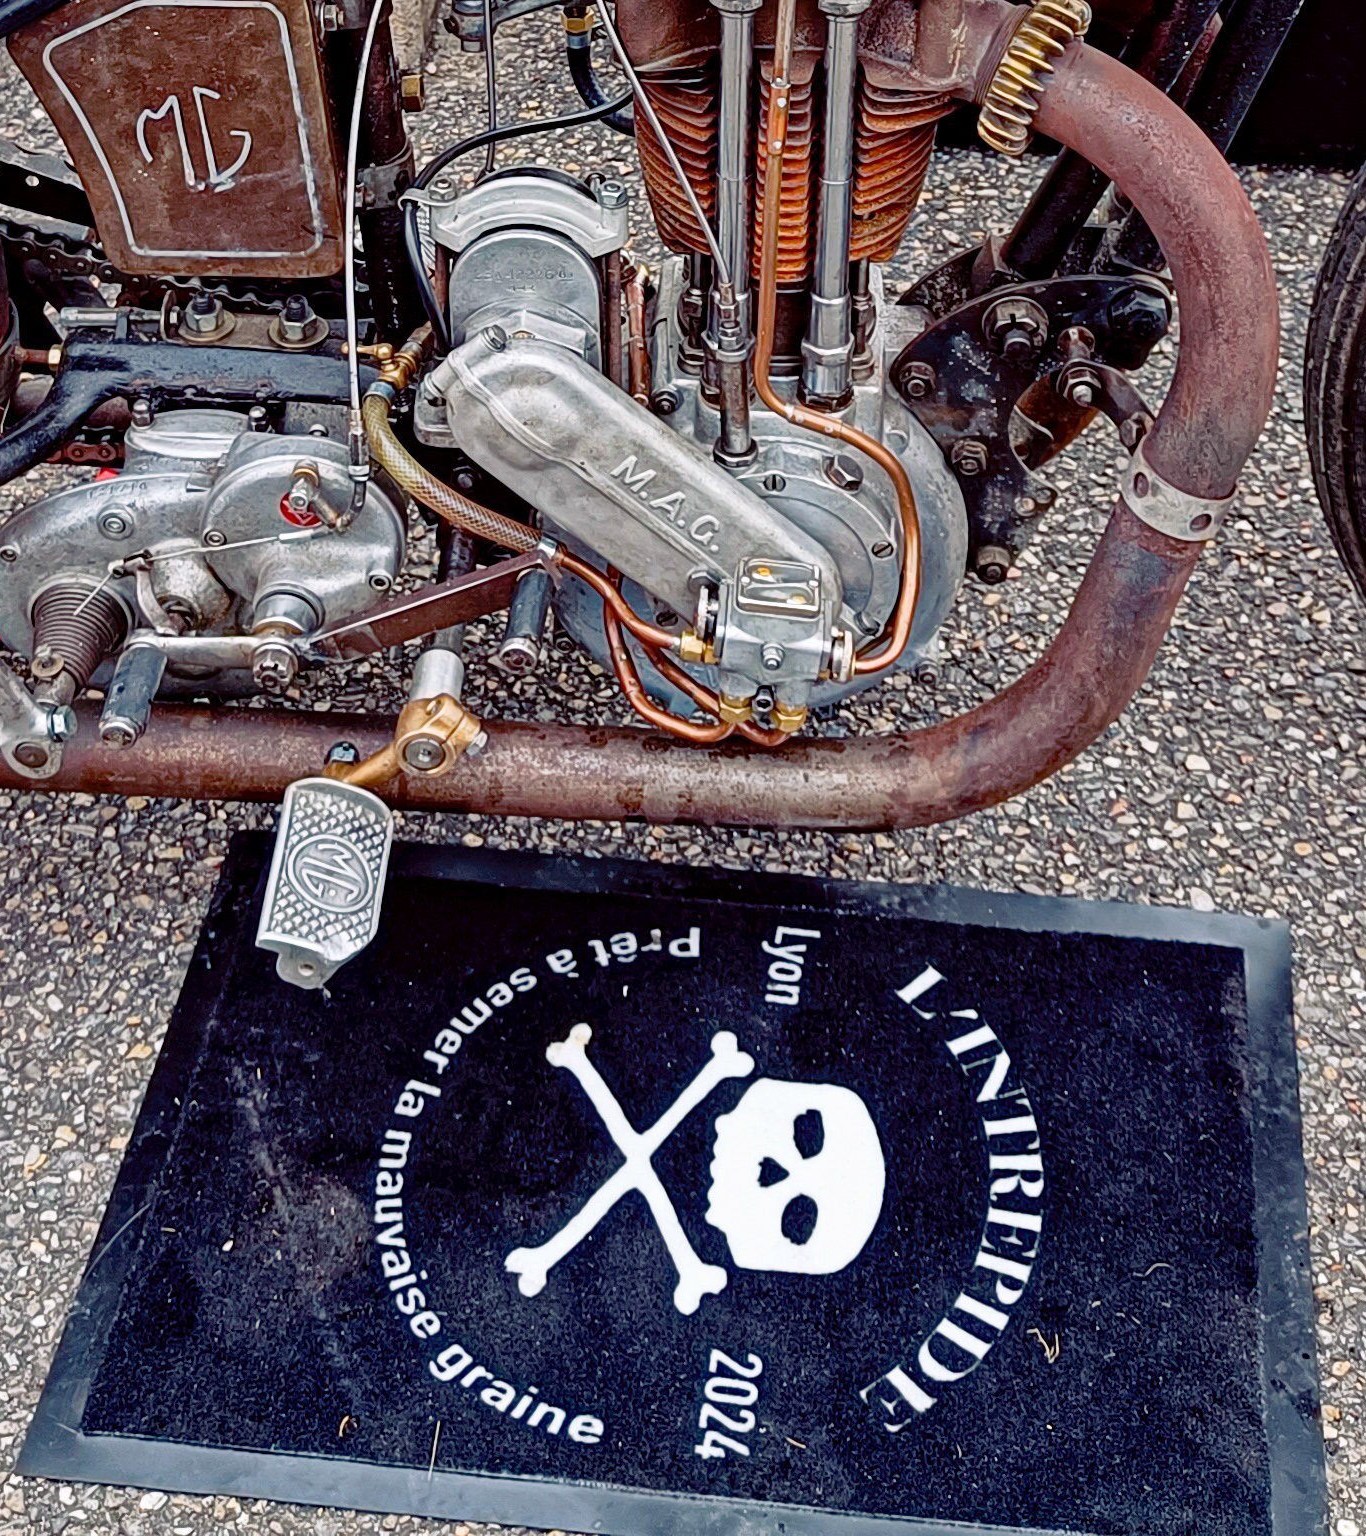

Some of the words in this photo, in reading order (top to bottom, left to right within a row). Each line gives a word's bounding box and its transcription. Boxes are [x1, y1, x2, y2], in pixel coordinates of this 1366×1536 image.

[135, 85, 253, 193] MG
[610, 453, 723, 553] M.A.G.
[545, 948, 579, 979] à
[587, 926, 702, 968] Prêt
[761, 925, 822, 1006] Lyon
[422, 967, 537, 1075] semer
[394, 1079, 443, 1118] la
[374, 1129, 442, 1339] mauvaise
[860, 962, 1045, 1433] L'INTREPIDE
[429, 1342, 605, 1444] graine
[694, 1348, 763, 1460] 2024
